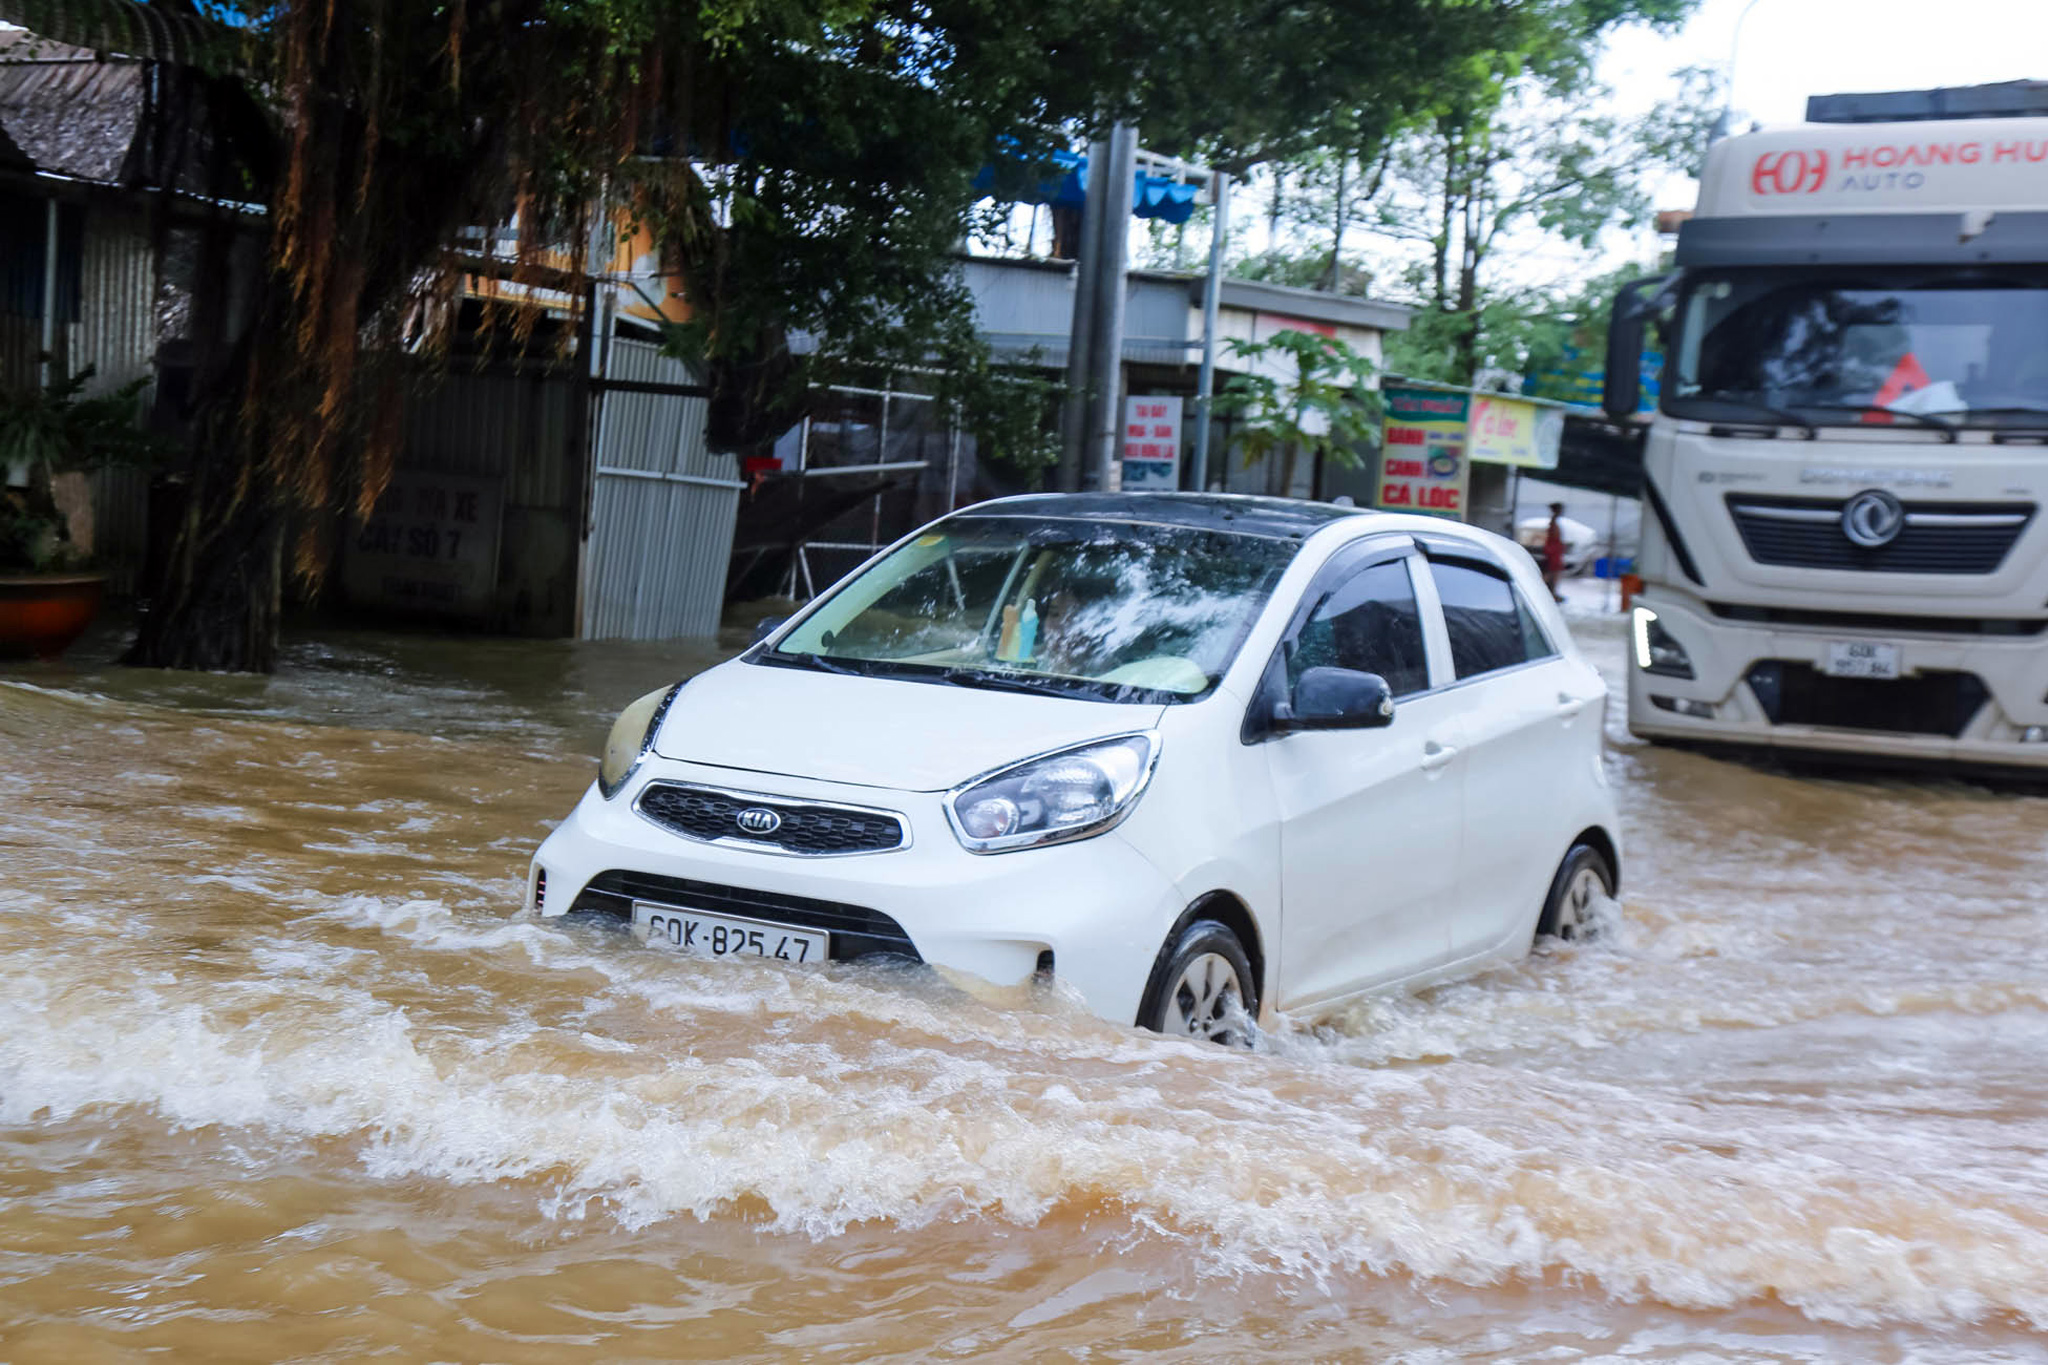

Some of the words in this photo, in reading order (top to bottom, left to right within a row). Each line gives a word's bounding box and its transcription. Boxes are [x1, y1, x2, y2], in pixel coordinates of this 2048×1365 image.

[1842, 143, 1981, 170] HOANG
[1841, 172, 1925, 192] AUTO
[446, 529, 462, 560] 7
[742, 811, 773, 829] KIA
